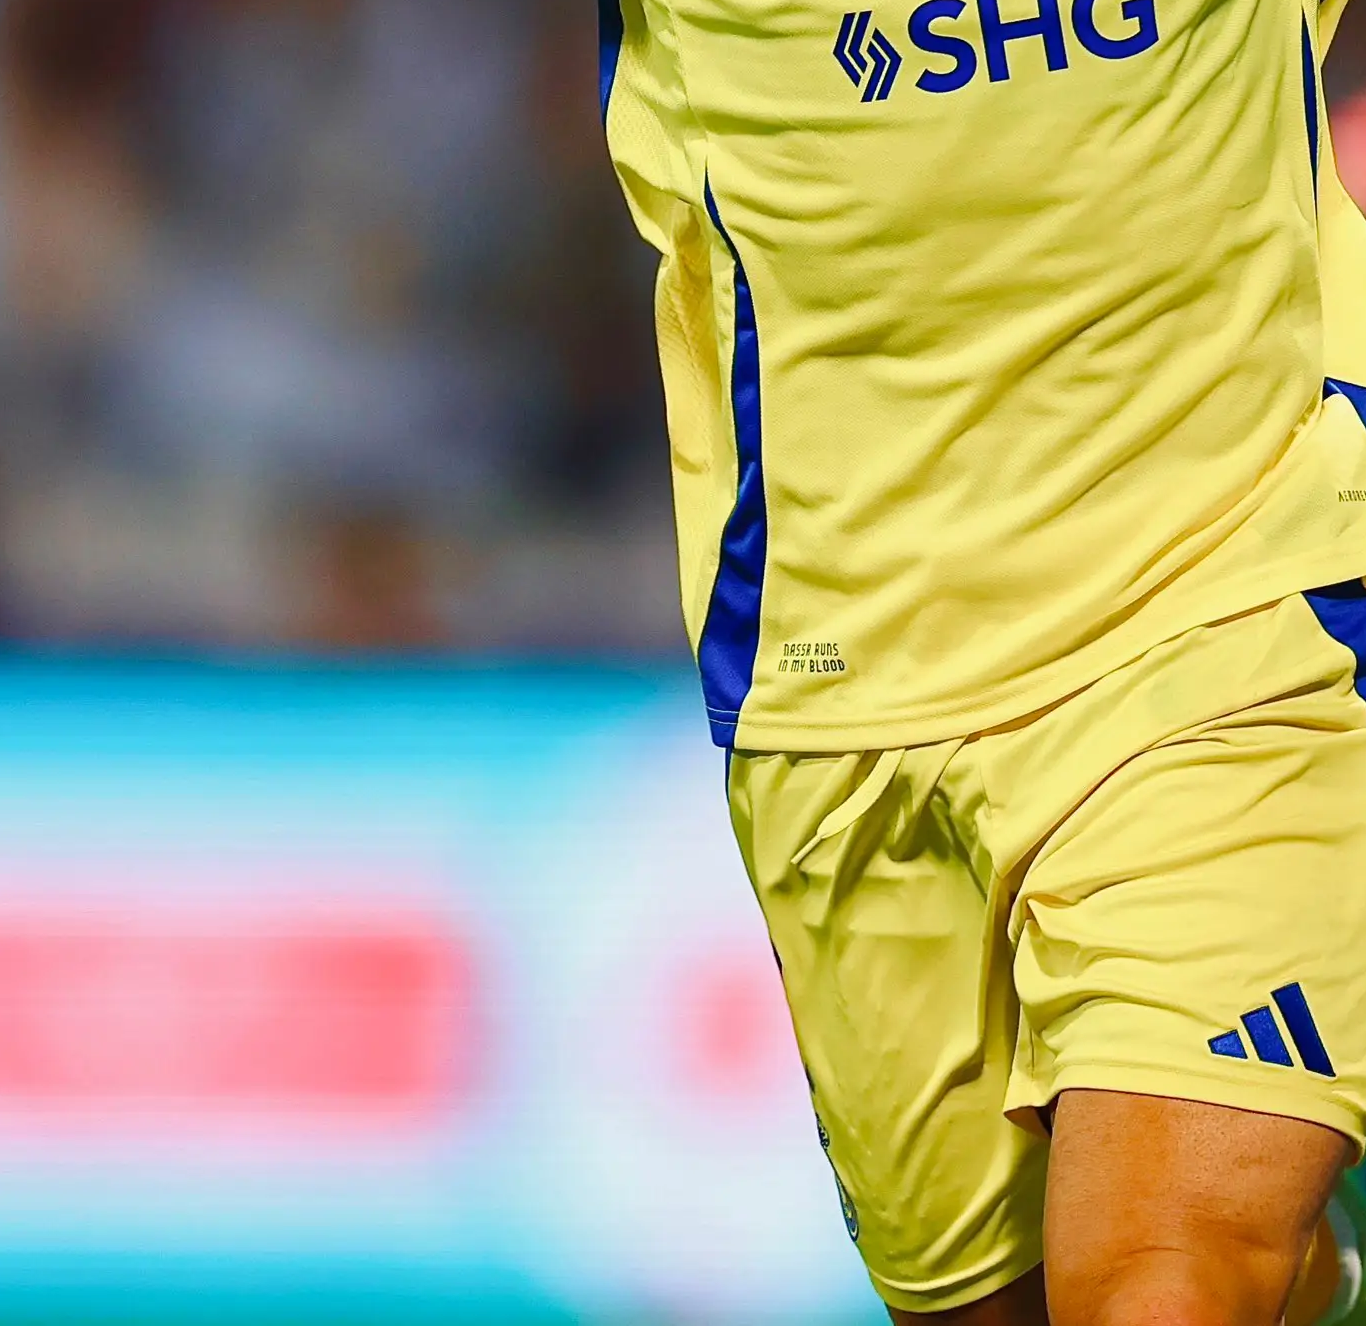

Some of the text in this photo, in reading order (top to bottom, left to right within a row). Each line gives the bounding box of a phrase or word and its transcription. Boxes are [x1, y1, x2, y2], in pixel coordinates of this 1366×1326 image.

[784, 642, 839, 656] NASSR RUNS
[791, 659, 806, 672] MY
[809, 659, 845, 672] BLOOD
